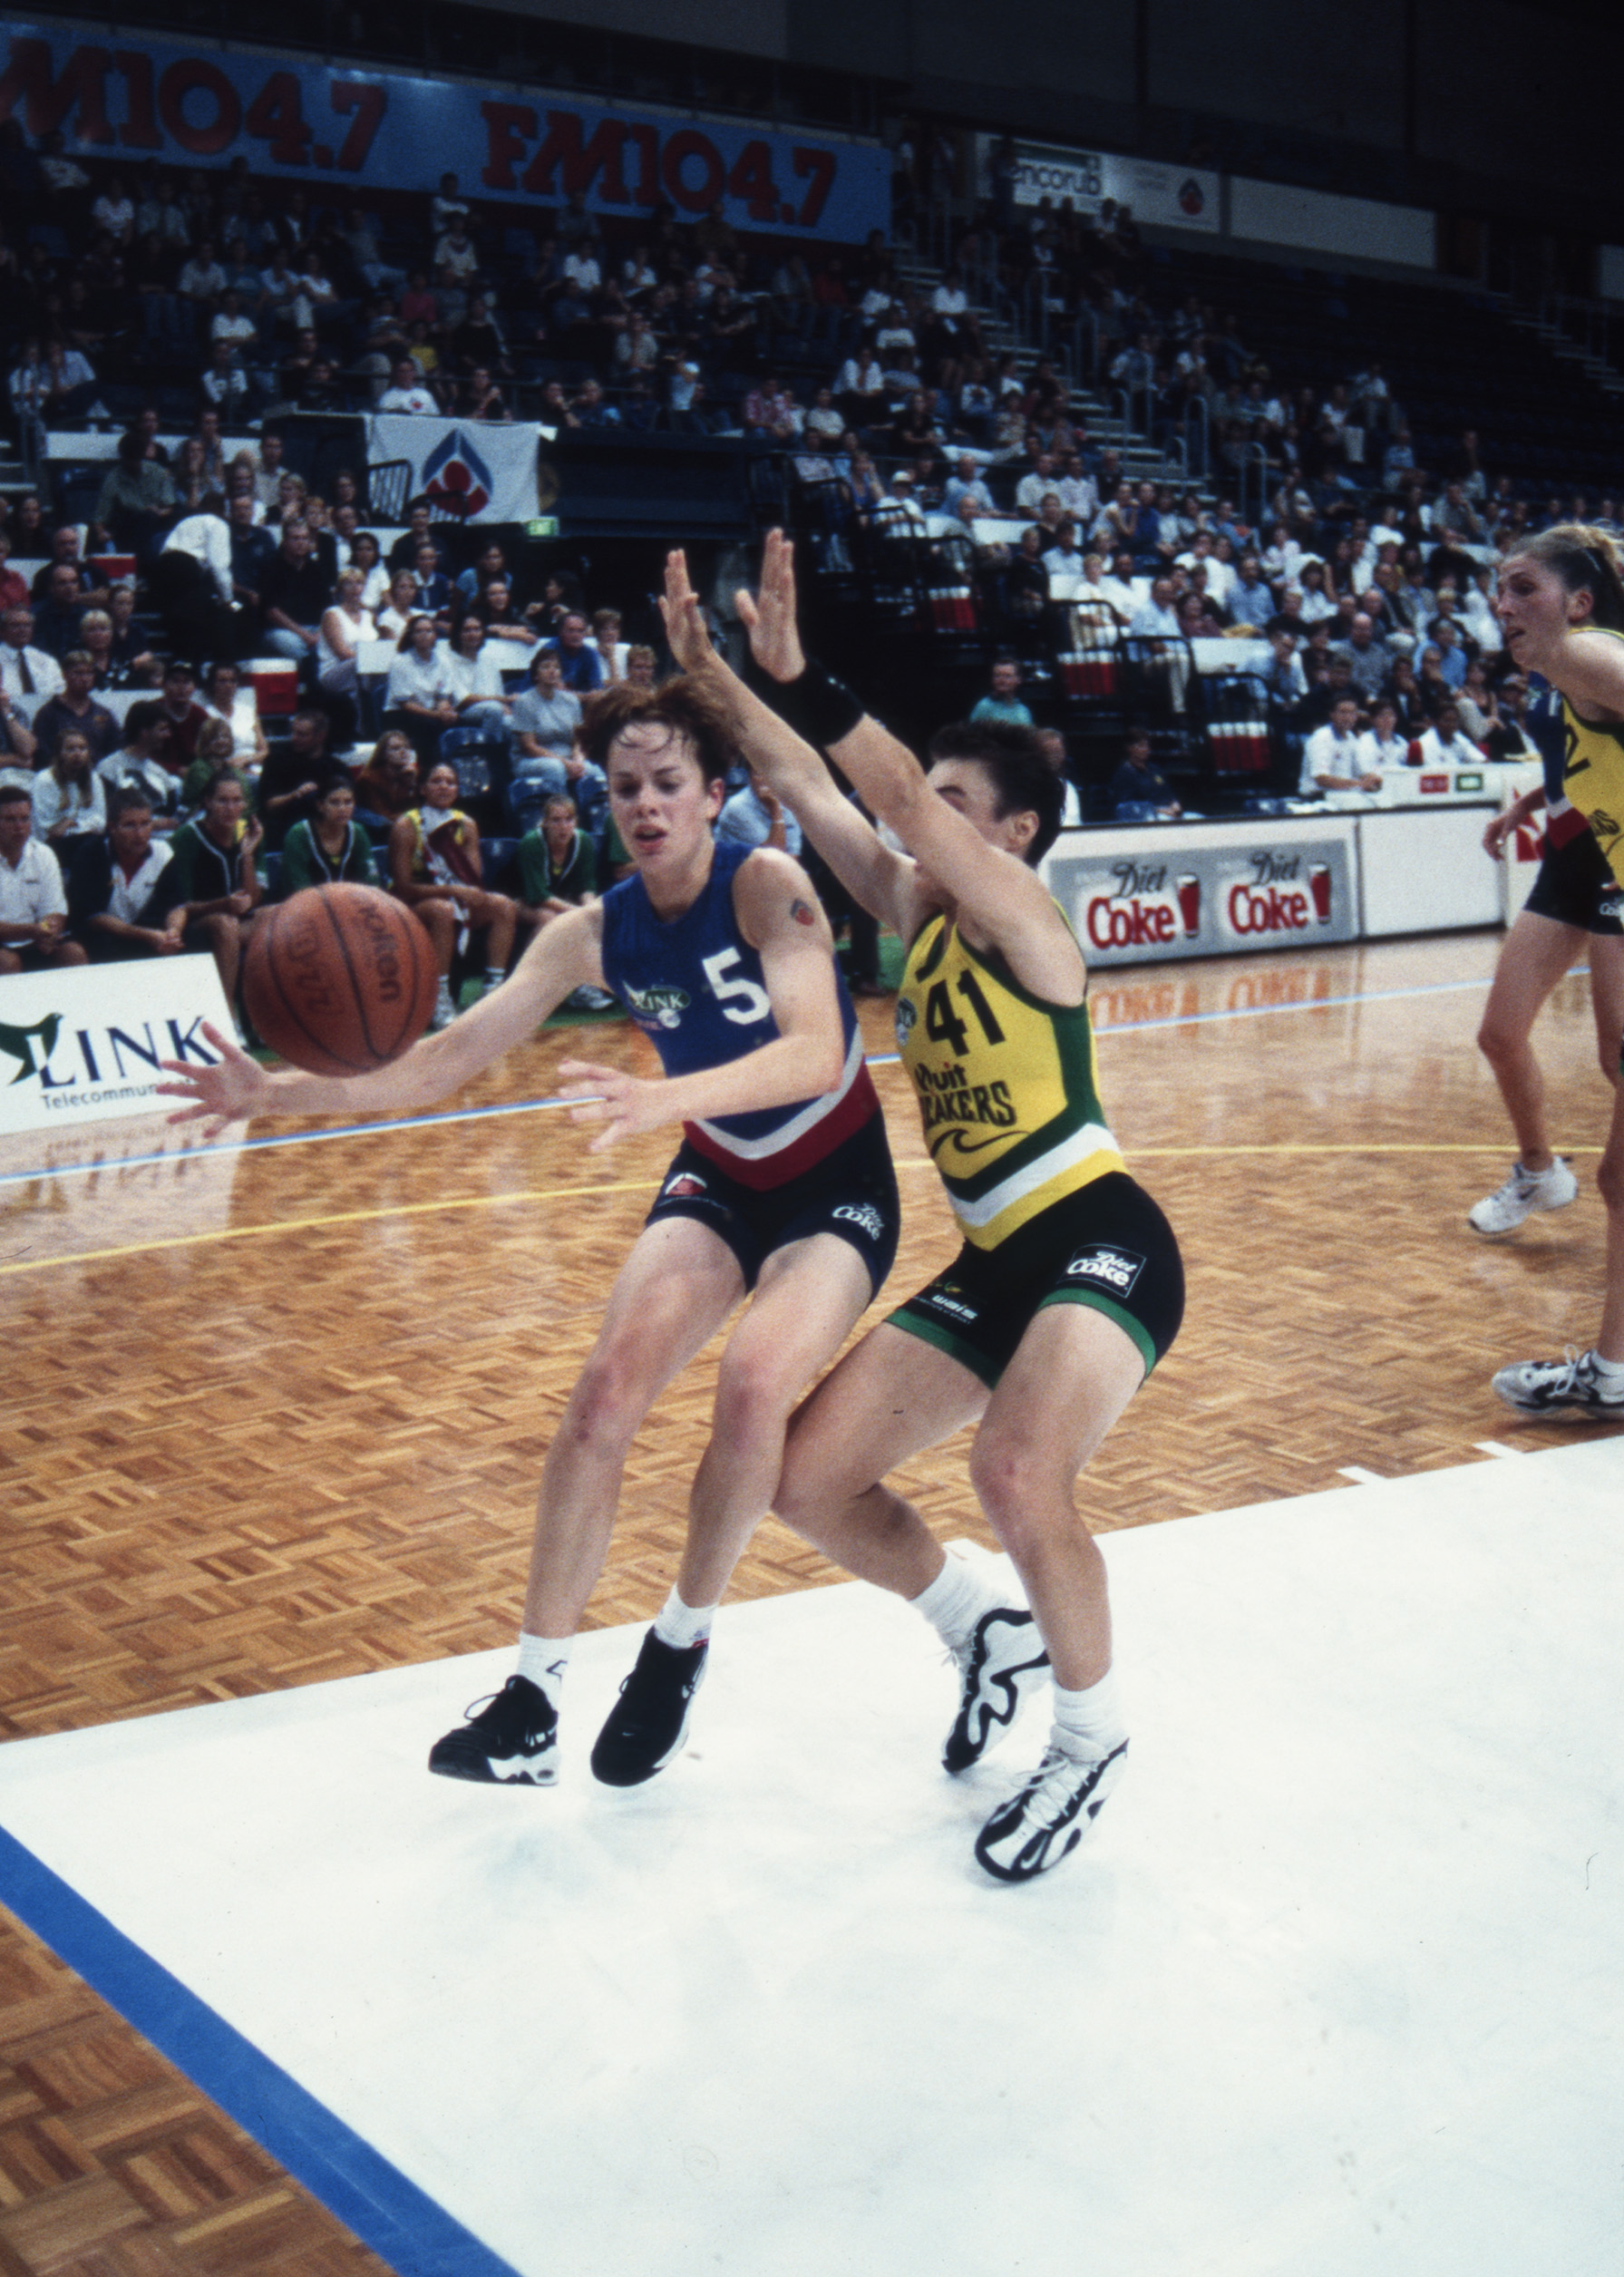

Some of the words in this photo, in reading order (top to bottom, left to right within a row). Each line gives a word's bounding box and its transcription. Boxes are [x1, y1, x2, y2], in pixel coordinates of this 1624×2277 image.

[481, 101, 837, 228] FM104.7
[1008, 164, 1102, 196] encorub
[1110, 862, 1168, 899] Diet
[1249, 851, 1300, 886] Diet
[1087, 896, 1175, 949] Coke
[1229, 884, 1308, 934] Coke
[702, 946, 771, 1025] 5
[926, 968, 1006, 1057] 41
[25, 1016, 219, 1089] LINK
[41, 1083, 158, 1110] Telecommun
[832, 1205, 880, 1241] Coke
[1066, 1258, 1131, 1286] Coke
[1095, 1250, 1138, 1273] Diet
